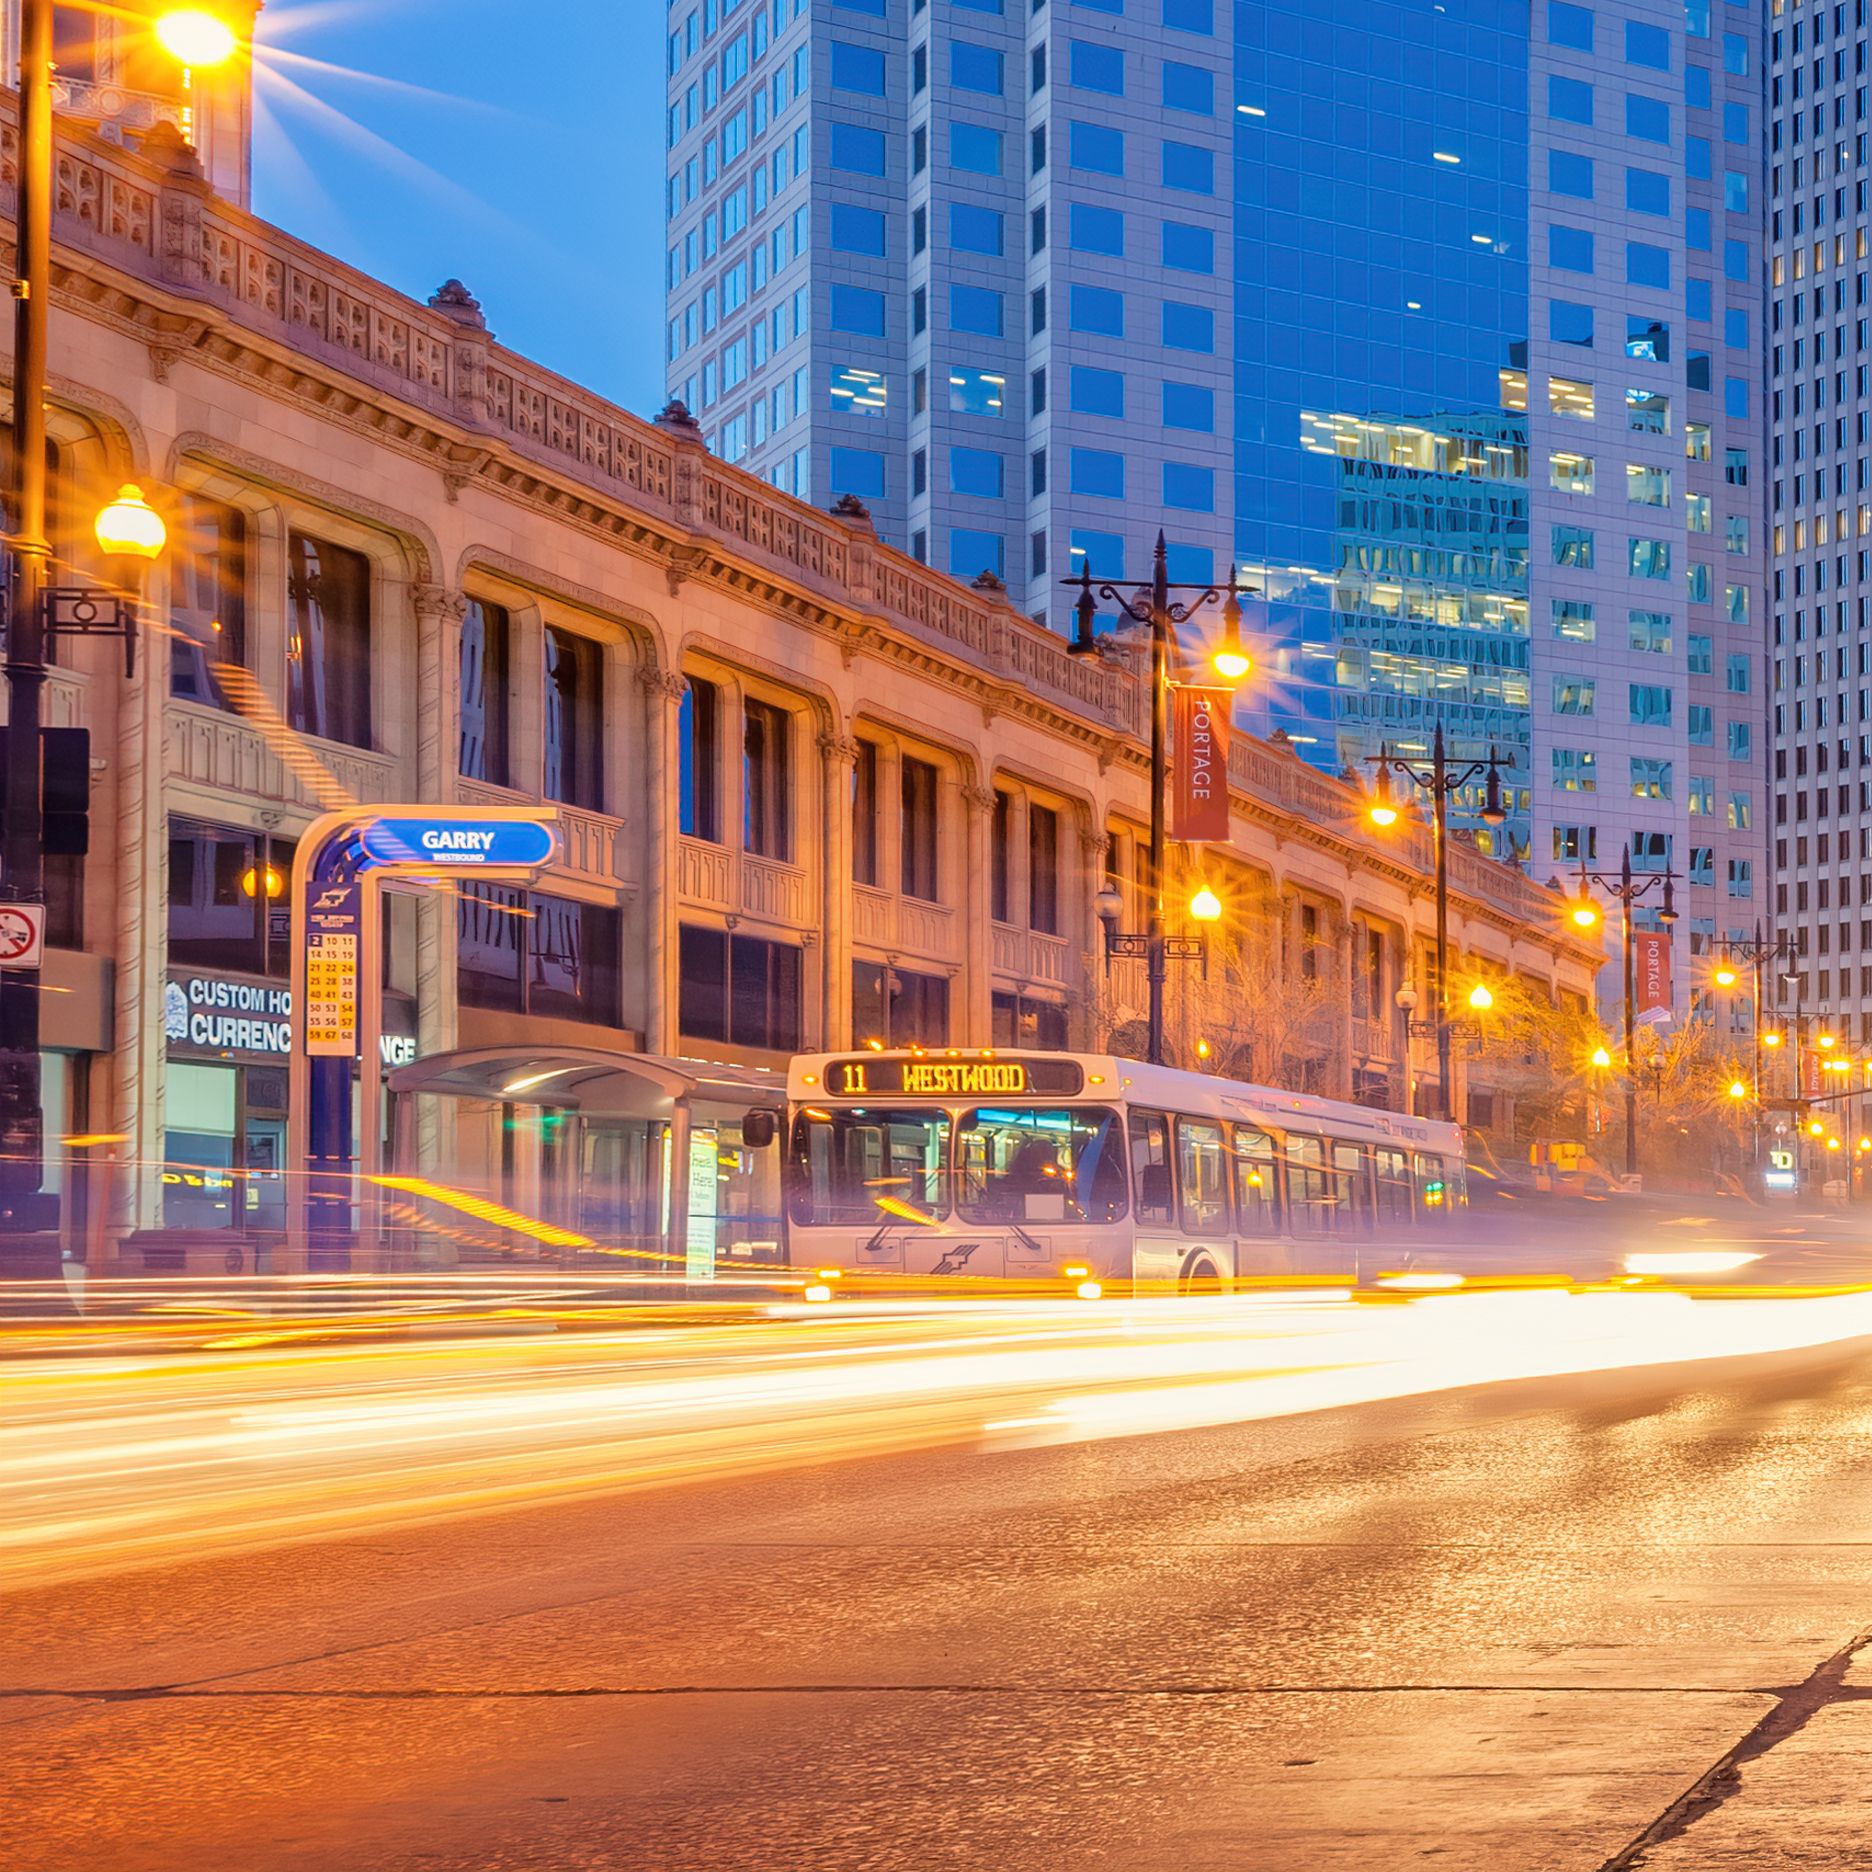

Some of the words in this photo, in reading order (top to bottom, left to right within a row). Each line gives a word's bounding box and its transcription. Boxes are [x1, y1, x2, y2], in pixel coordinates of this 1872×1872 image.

[1193, 699, 1212, 800] PORTAGE
[422, 830, 496, 850] GARRY
[1647, 940, 1660, 998] PORTAGE
[190, 979, 265, 1010] CUSTOM
[191, 1014, 291, 1052] CURRENC
[844, 1065, 867, 1092] 11
[903, 1064, 1025, 1092] WESTWOOD
[1770, 1150, 1793, 1169] TD
